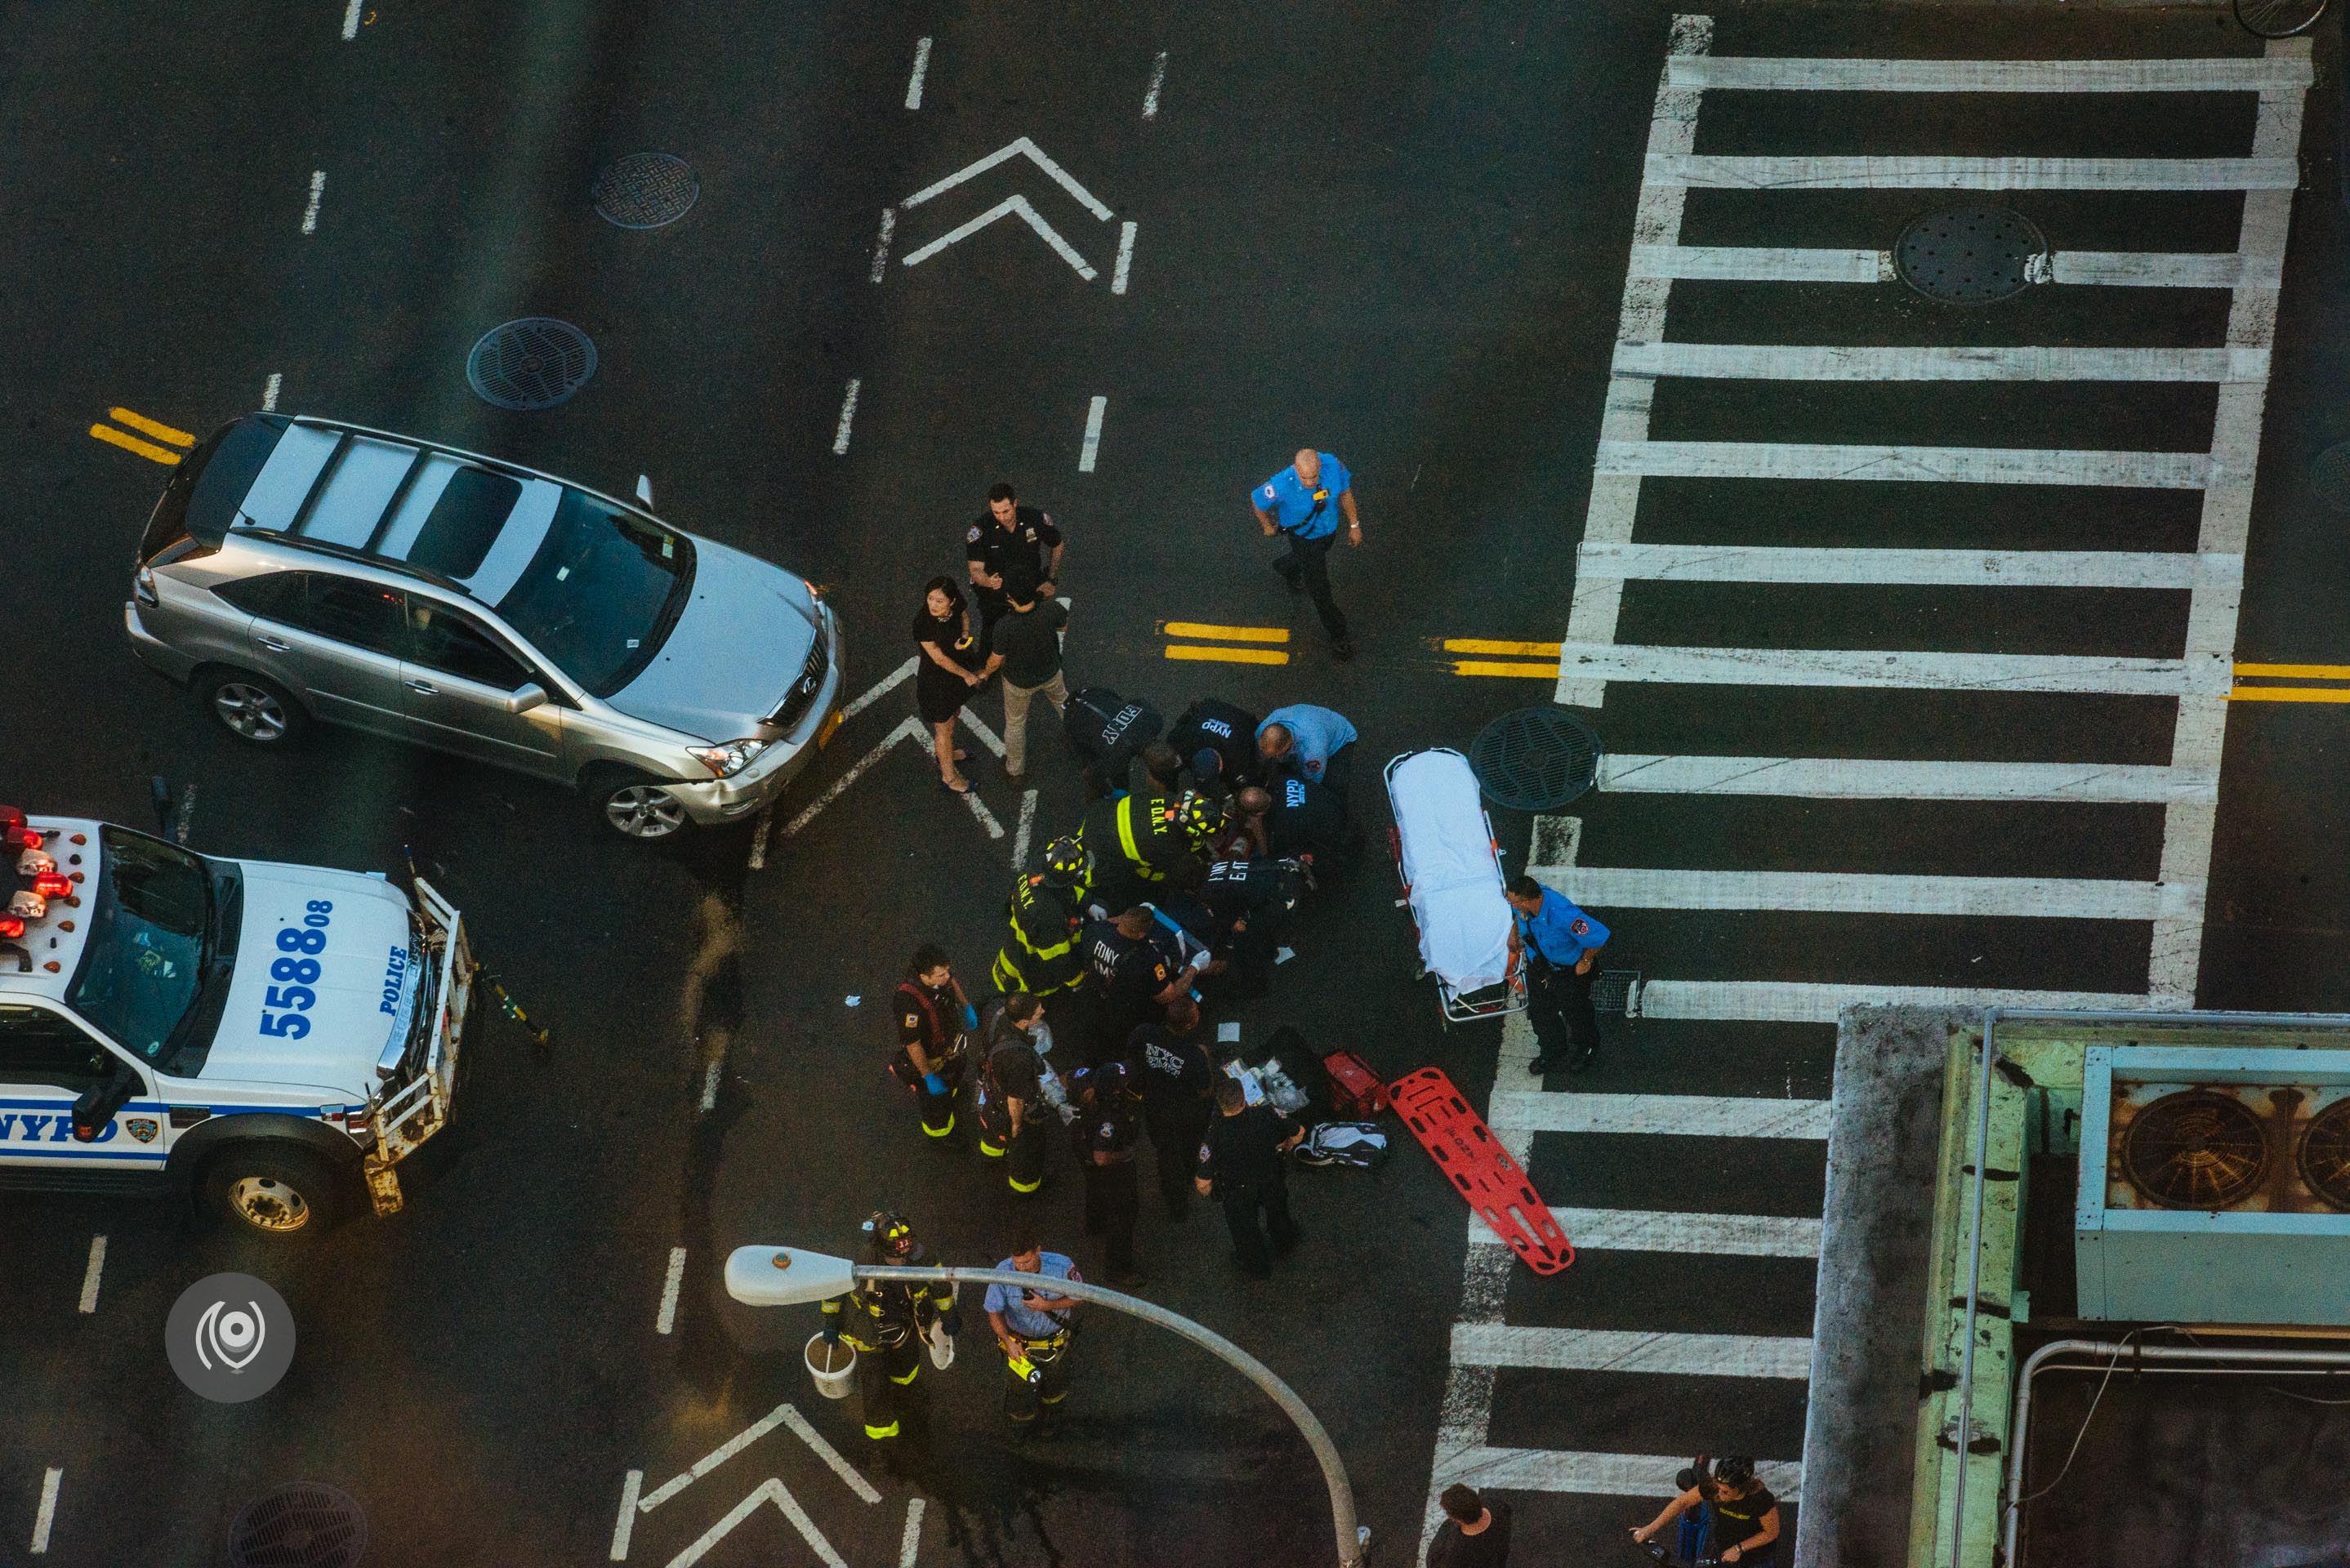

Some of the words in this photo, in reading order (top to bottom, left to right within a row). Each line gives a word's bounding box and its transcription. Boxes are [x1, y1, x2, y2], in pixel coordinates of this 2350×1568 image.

[1202, 720, 1233, 739] NYPD
[1286, 779, 1300, 808] NYPD
[1094, 940, 1120, 967] FDNY
[380, 946, 407, 1017] POLICE
[1146, 1043, 1184, 1069] NYC
